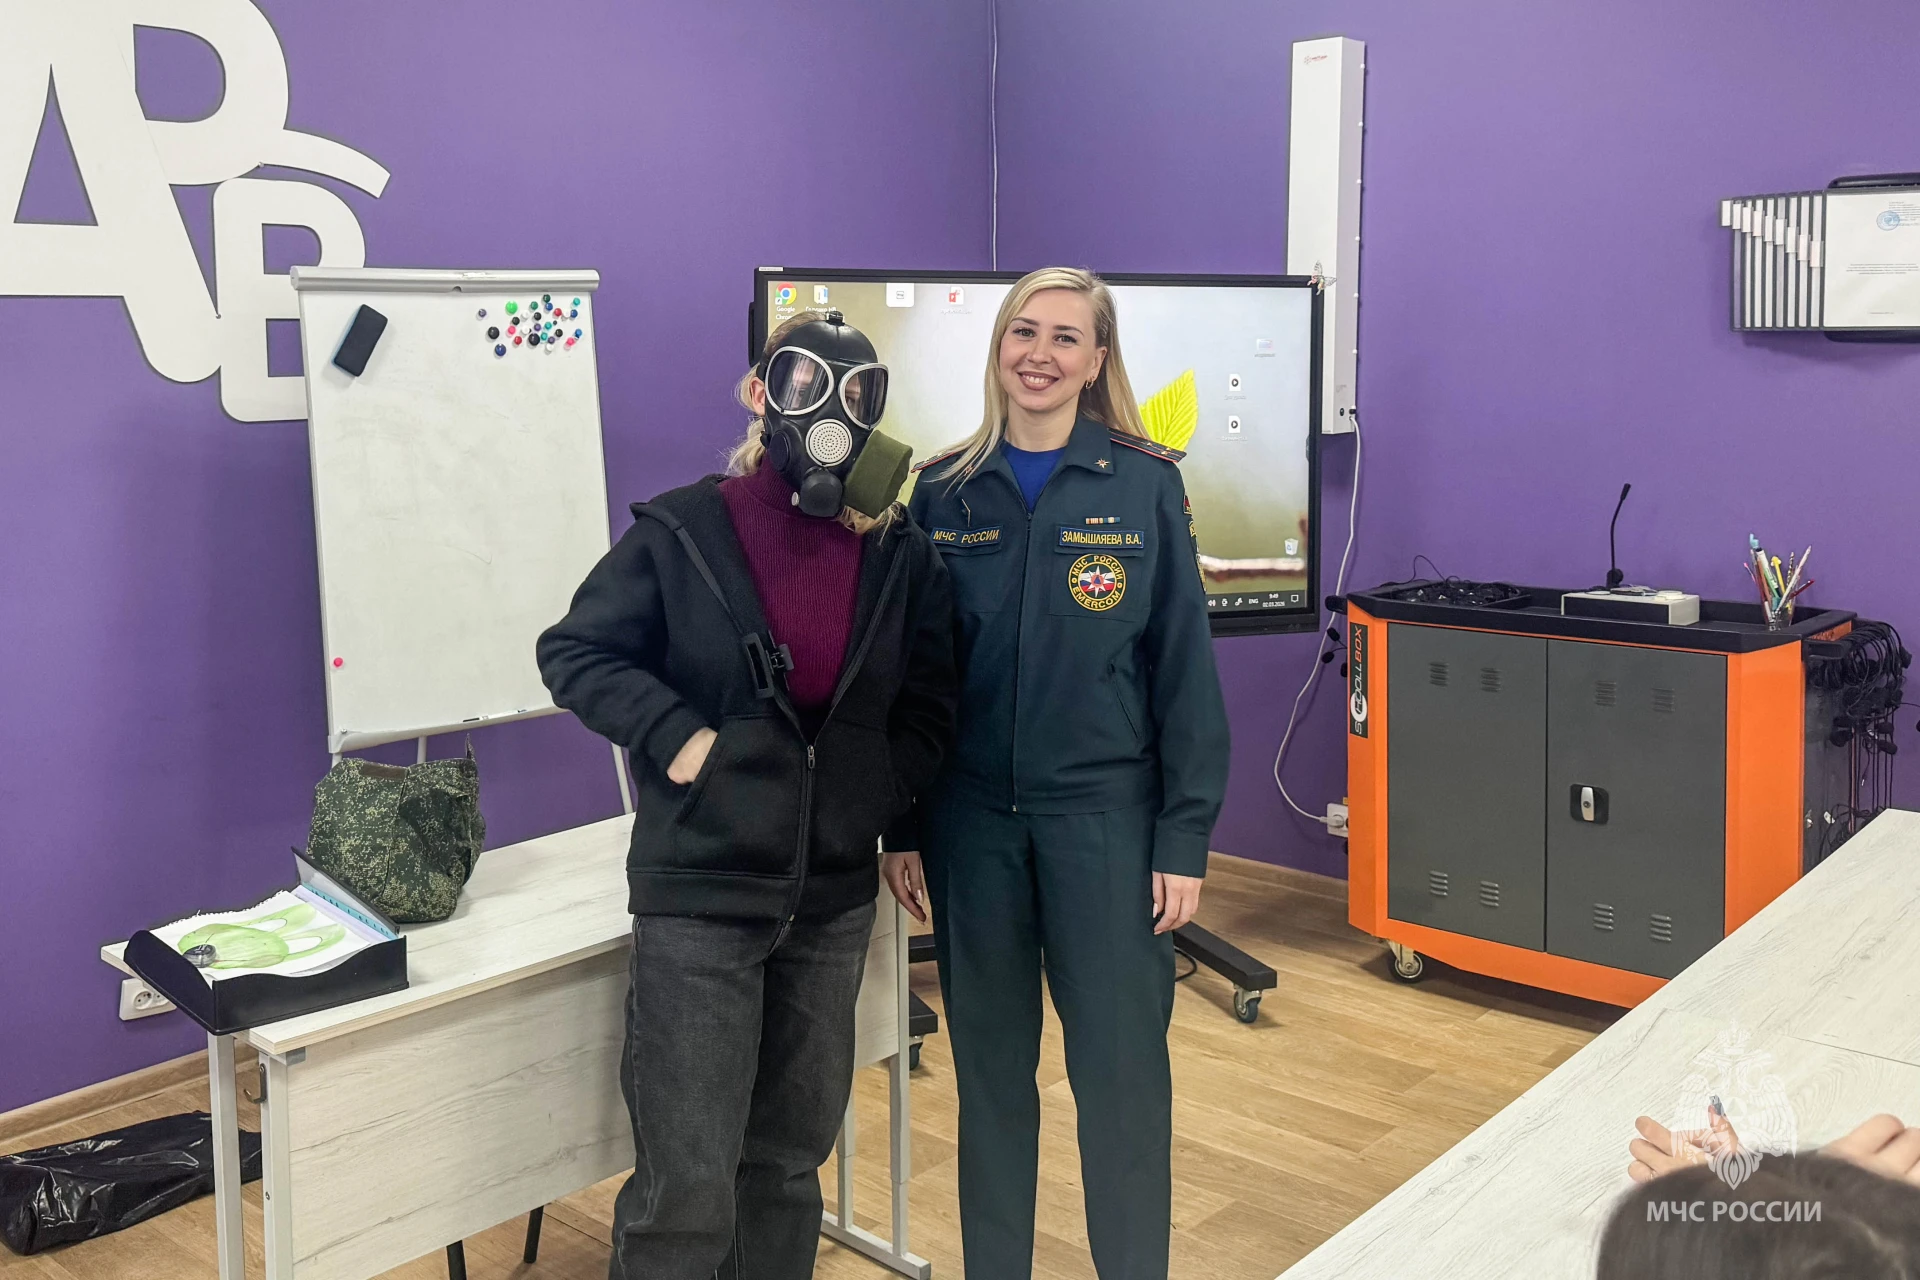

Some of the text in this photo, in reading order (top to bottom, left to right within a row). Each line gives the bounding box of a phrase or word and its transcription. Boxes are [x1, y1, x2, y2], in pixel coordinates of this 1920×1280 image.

[776, 306, 796, 314] Google
[933, 529, 1000, 544] МЧС РОССИИ
[1062, 530, 1142, 545] ЗАМЫШЛЯЕВА В.А.
[1071, 555, 1124, 580] МЧС РОССИИ
[1072, 585, 1121, 609] EMERCOM
